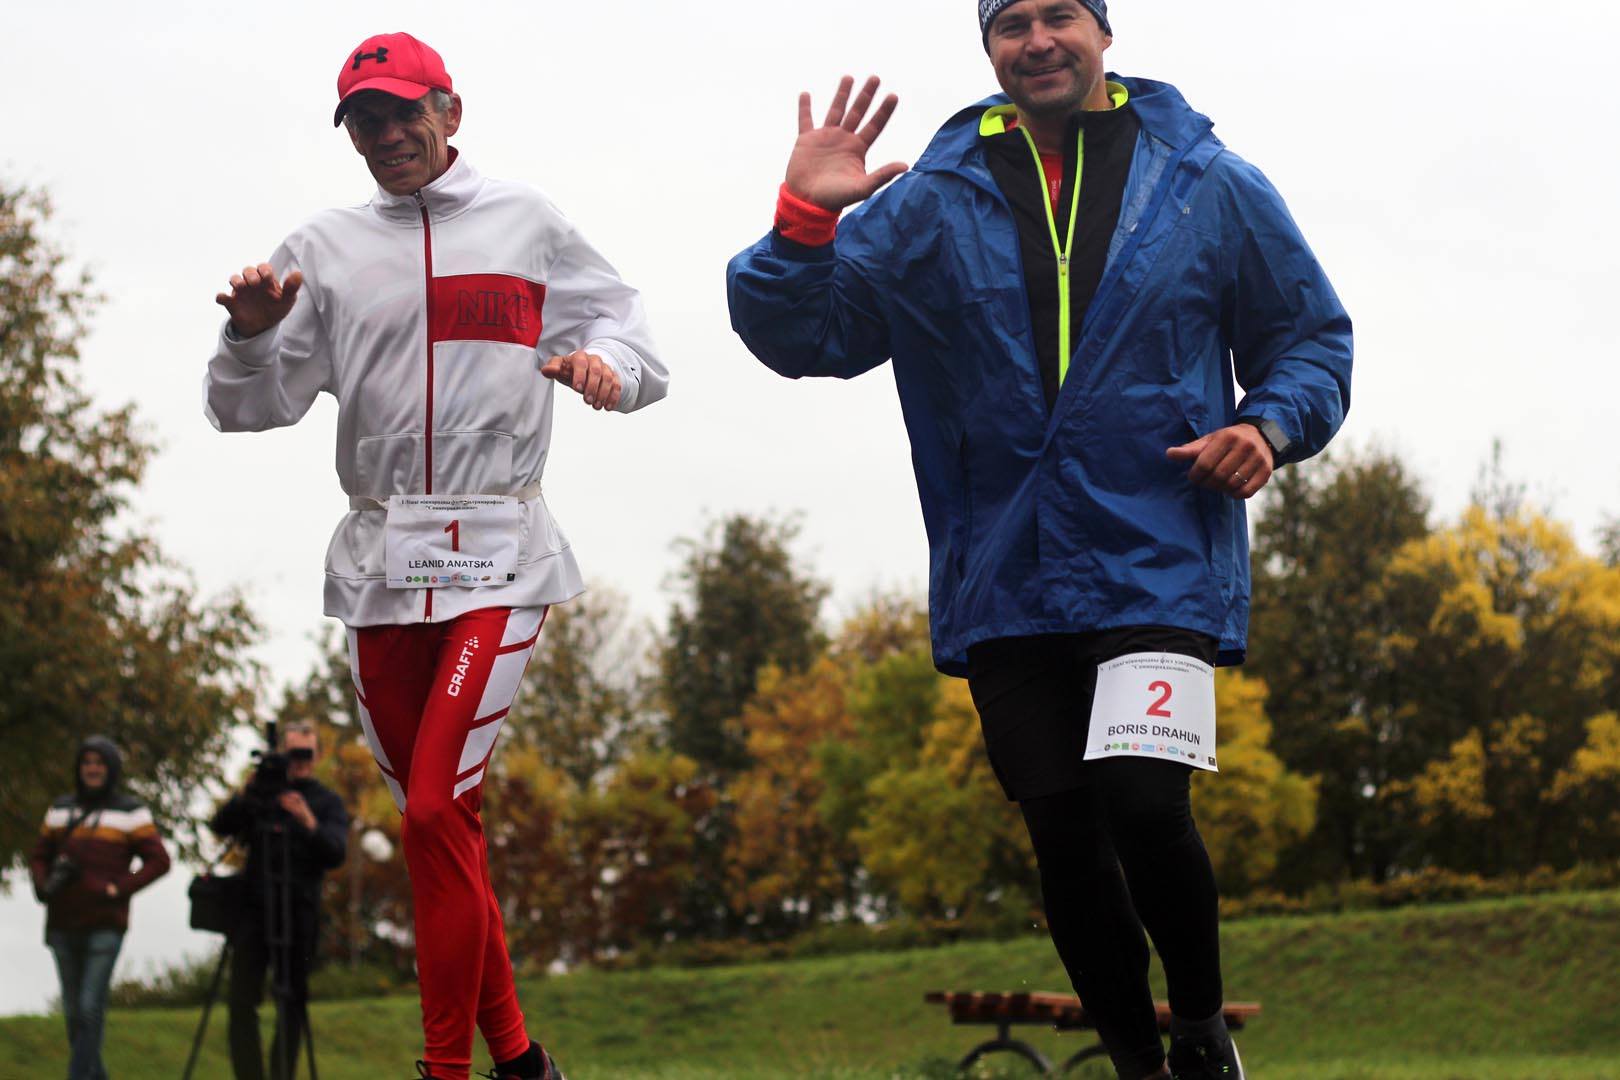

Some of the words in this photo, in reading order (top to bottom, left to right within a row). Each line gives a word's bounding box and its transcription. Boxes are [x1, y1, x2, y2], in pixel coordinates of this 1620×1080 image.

[457, 288, 529, 332] NIKE
[444, 519, 460, 552] 1
[408, 559, 445, 569] LEANID
[446, 559, 494, 569] ANATSKA
[447, 646, 474, 697] CRAFT
[1146, 680, 1173, 718] 2
[1107, 723, 1148, 737] BORIS
[1152, 725, 1201, 746] DRAHUN
